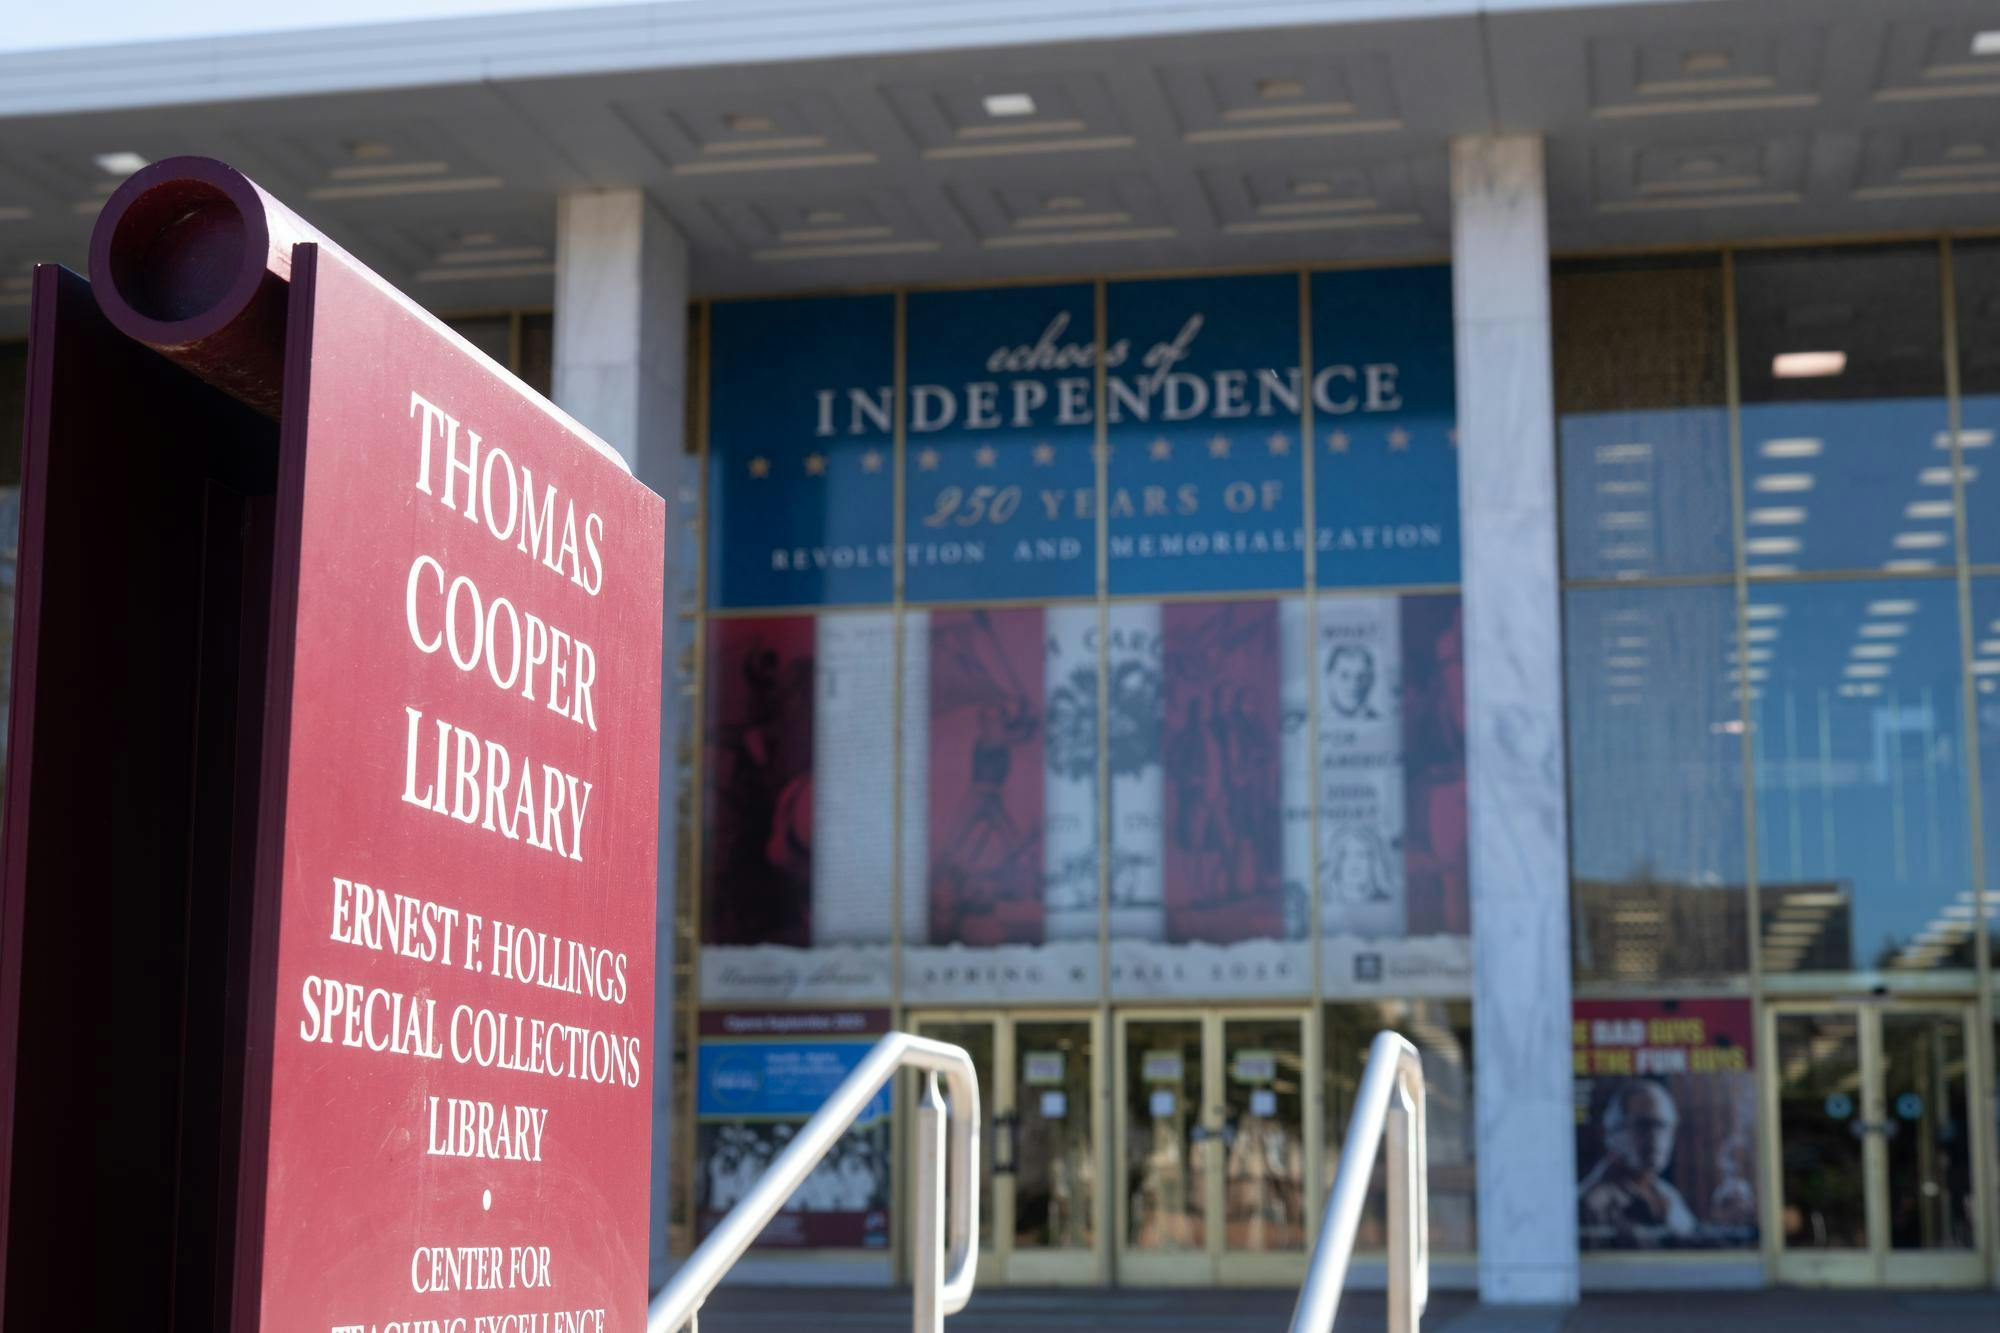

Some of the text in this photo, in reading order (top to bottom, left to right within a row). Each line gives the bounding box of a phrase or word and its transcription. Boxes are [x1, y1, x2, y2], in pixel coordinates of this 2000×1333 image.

[986, 310, 1204, 395] echoes of
[816, 362, 1404, 437] INDEPENDENCE
[410, 391, 604, 597] THOMAS
[922, 479, 1284, 529] 250 YEARS OF
[770, 522, 1443, 571] REVOLUTION AND MEMORIALIZATION
[405, 554, 599, 732] COOPER
[401, 706, 593, 862] LIBRARY
[330, 877, 459, 966] ERNEST
[463, 913, 483, 974] F.
[491, 920, 627, 1005] HOLLINGS
[300, 975, 641, 1088] SPECIAL COLLECTIONS
[1591, 1019, 1646, 1045] BAD
[1648, 1018, 1706, 1044] GUYS
[1690, 1045, 1746, 1073] GUYS
[427, 1096, 548, 1162] LIBRARY
[411, 1246, 552, 1293] CENTER FOR
